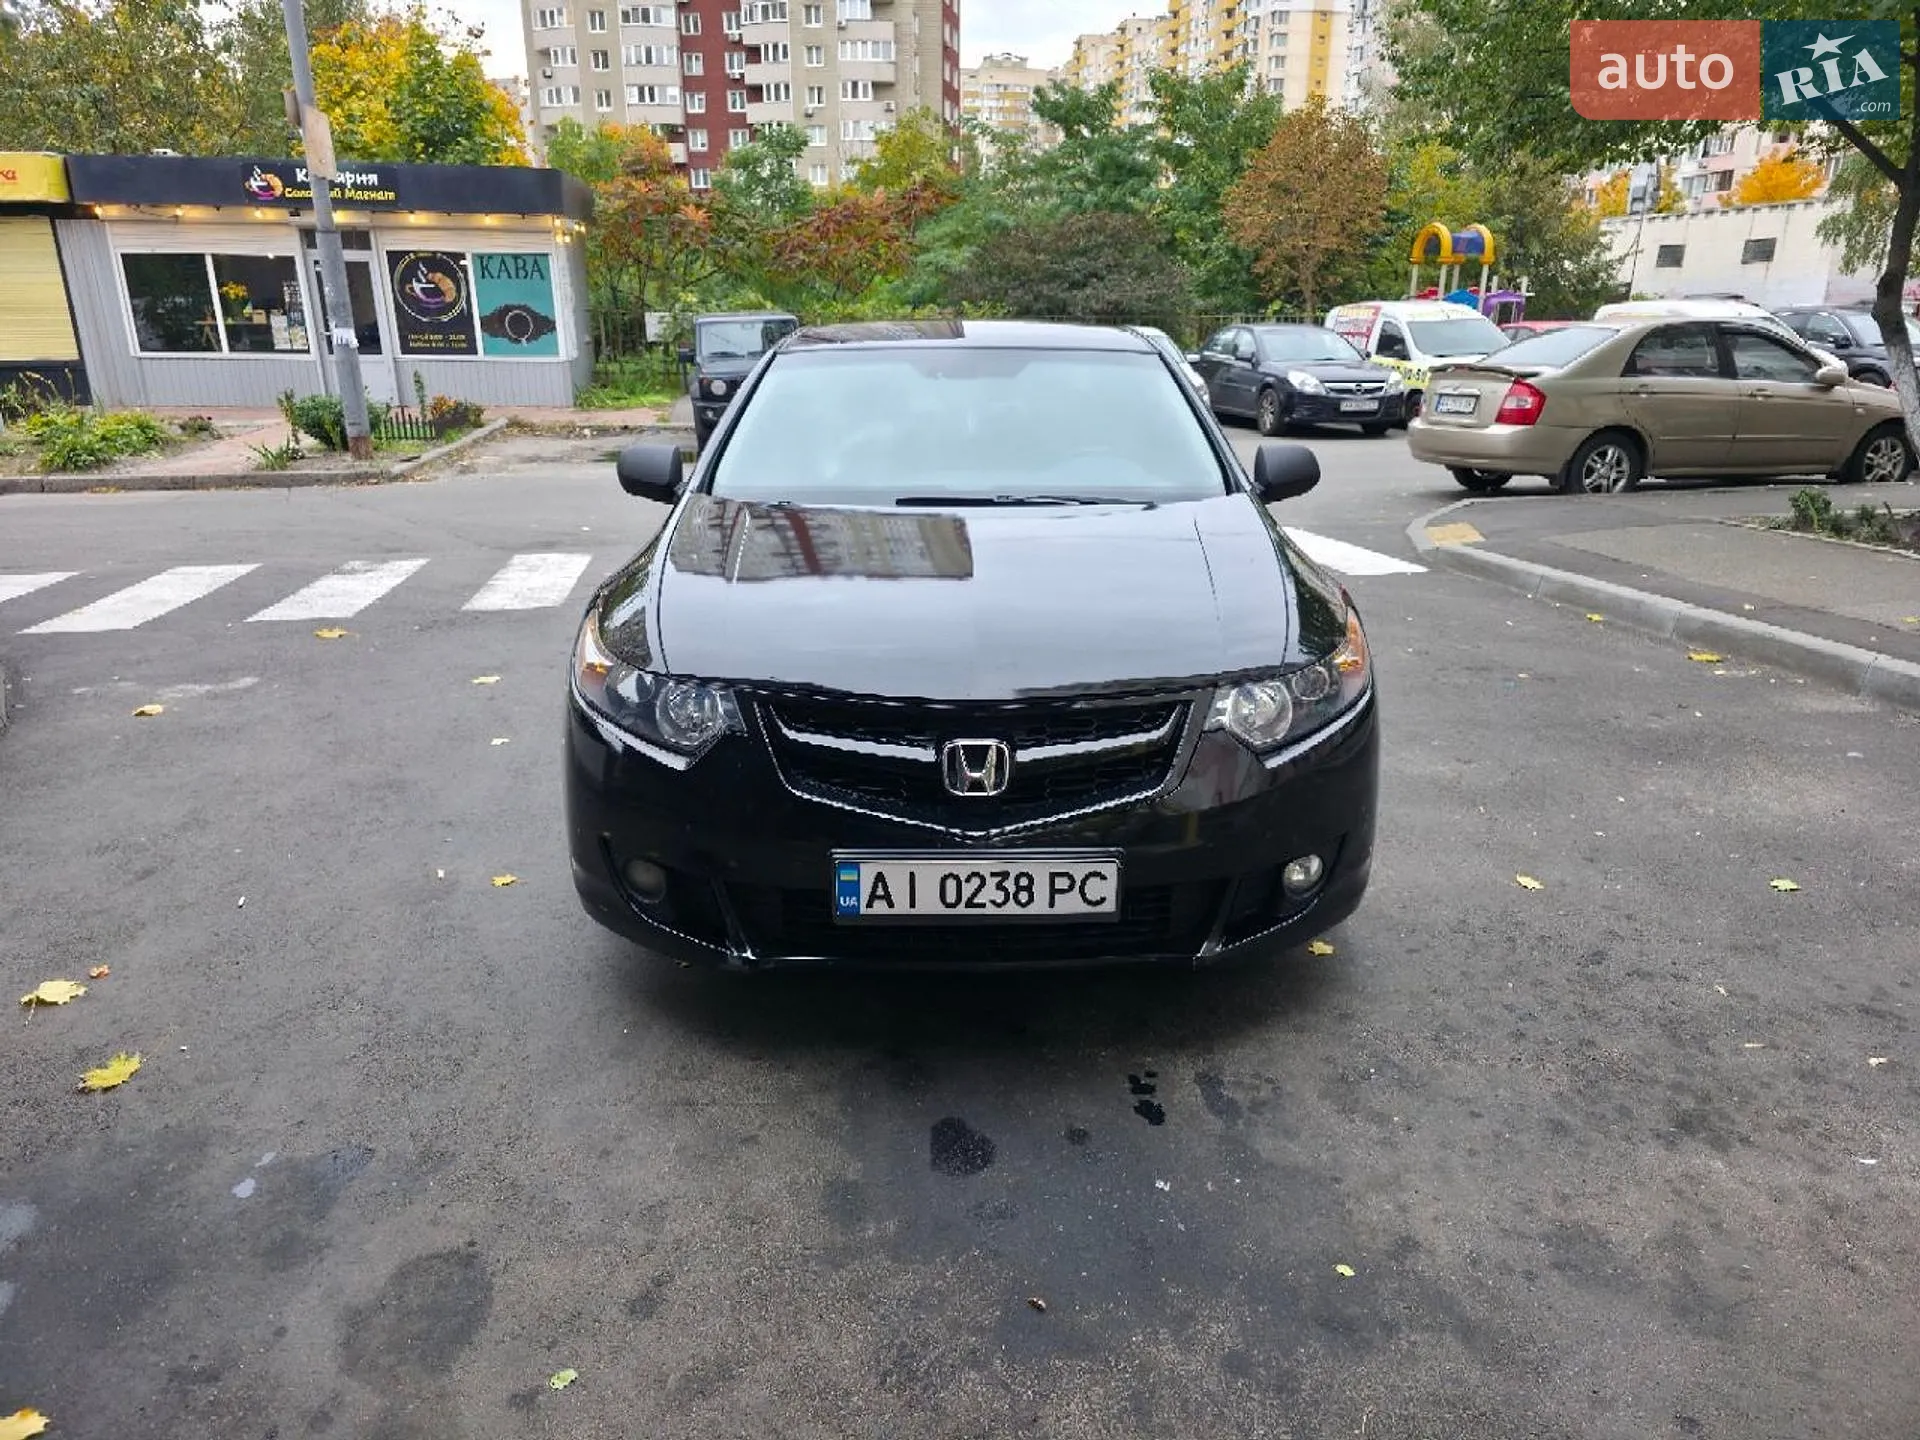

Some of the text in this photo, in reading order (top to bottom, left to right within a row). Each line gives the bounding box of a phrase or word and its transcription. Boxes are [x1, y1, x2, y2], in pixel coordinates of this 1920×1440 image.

[480, 255, 545, 281] КАВА
[839, 895, 858, 907] UA
[938, 870, 1035, 909] 0238
[1048, 870, 1108, 908] PC
